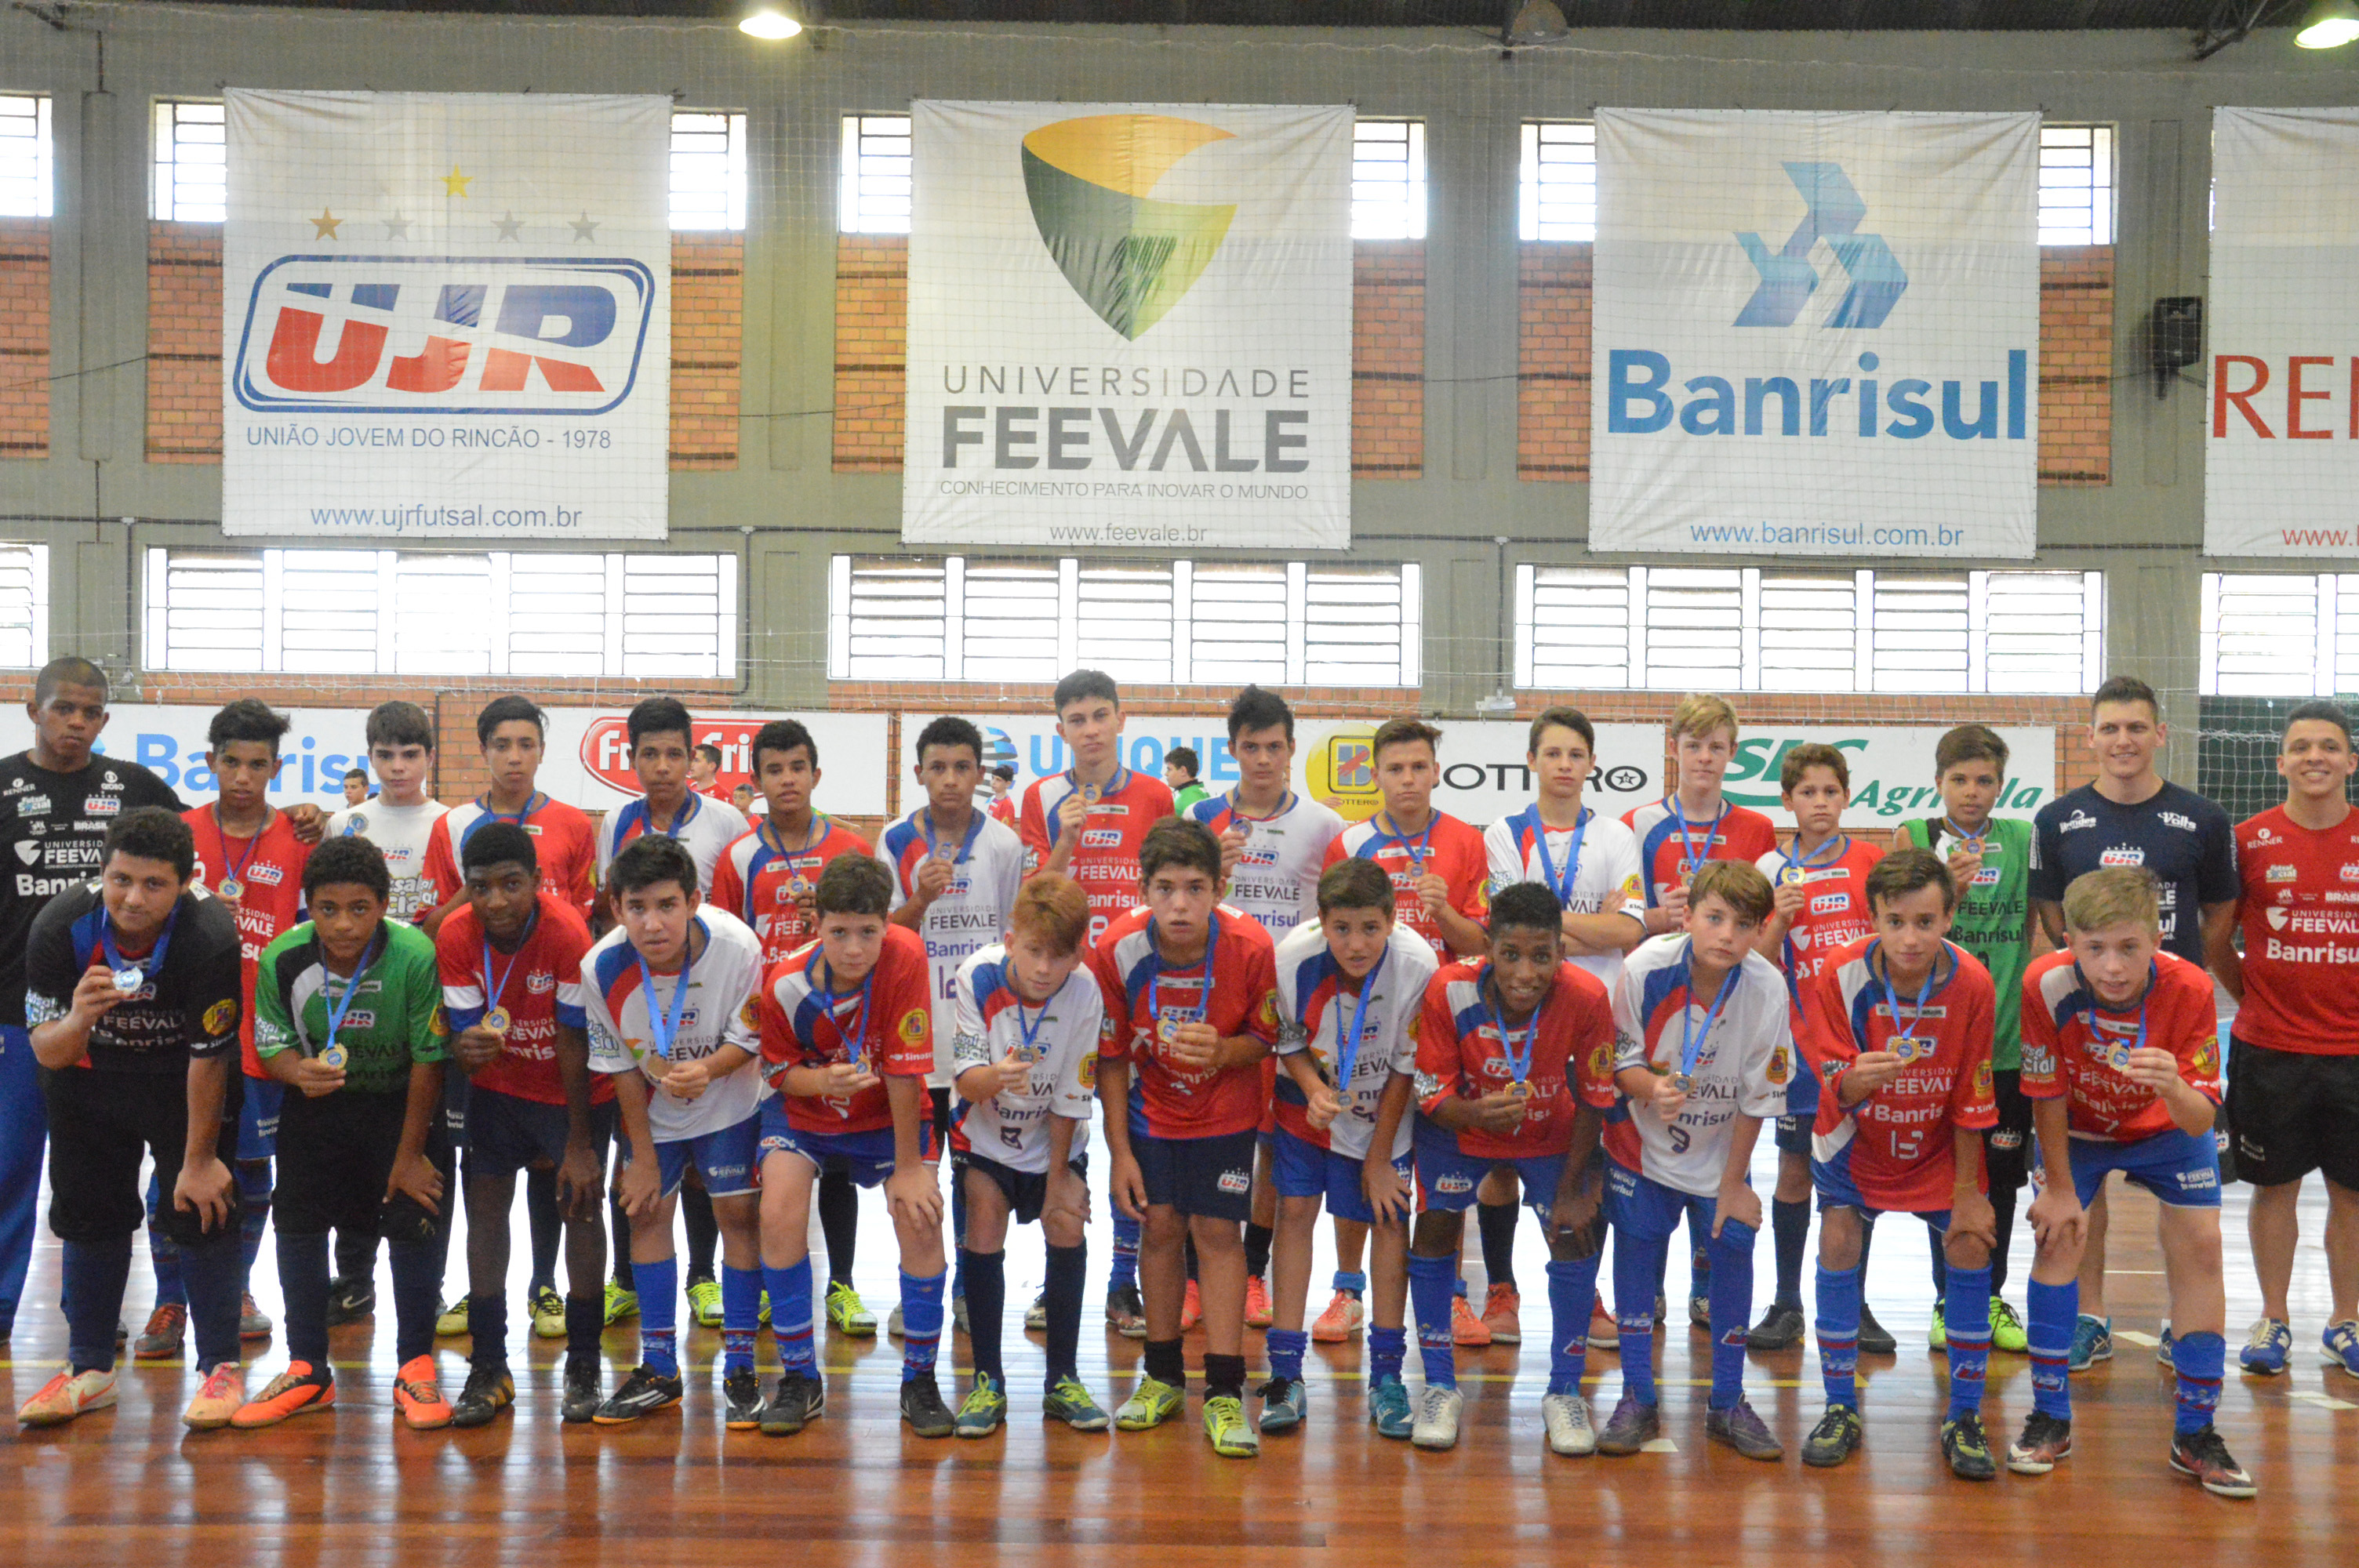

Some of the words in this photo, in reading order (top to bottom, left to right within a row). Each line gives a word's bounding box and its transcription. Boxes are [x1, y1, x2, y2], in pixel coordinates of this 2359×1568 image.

[266, 282, 617, 394] UJR
[943, 365, 1310, 398] UNIVERSIDADE
[1607, 349, 2027, 441] Banrisul
[247, 424, 319, 447] UNIÃO
[326, 428, 405, 448] JOVEM
[413, 429, 445, 448] DO
[453, 426, 540, 448] RINCÃO
[562, 430, 612, 449] 1978
[943, 405, 1310, 474] FEEVALE
[940, 480, 1089, 497] CONHECIMENTO
[1094, 481, 1143, 497] PARA
[1147, 482, 1216, 499] INOVAR
[1219, 484, 1234, 499] O
[1238, 484, 1308, 499] MUNDO
[311, 502, 582, 532] www.ujrfutsal.com.br
[1050, 522, 1207, 543] www.feevale.br
[1690, 520, 1964, 547] www.banrisul.com.br
[1083, 831, 1119, 846] UJR
[2247, 836, 2283, 849] RENNER
[1241, 851, 1275, 865] UJR
[2104, 854, 2138, 864] UJR
[1235, 884, 1300, 901] FEEVALE
[1813, 896, 1847, 912] UJR
[1957, 900, 2023, 916] FEEVALE
[929, 913, 998, 931] FEEVALE
[1668, 1124, 1691, 1154] 9
